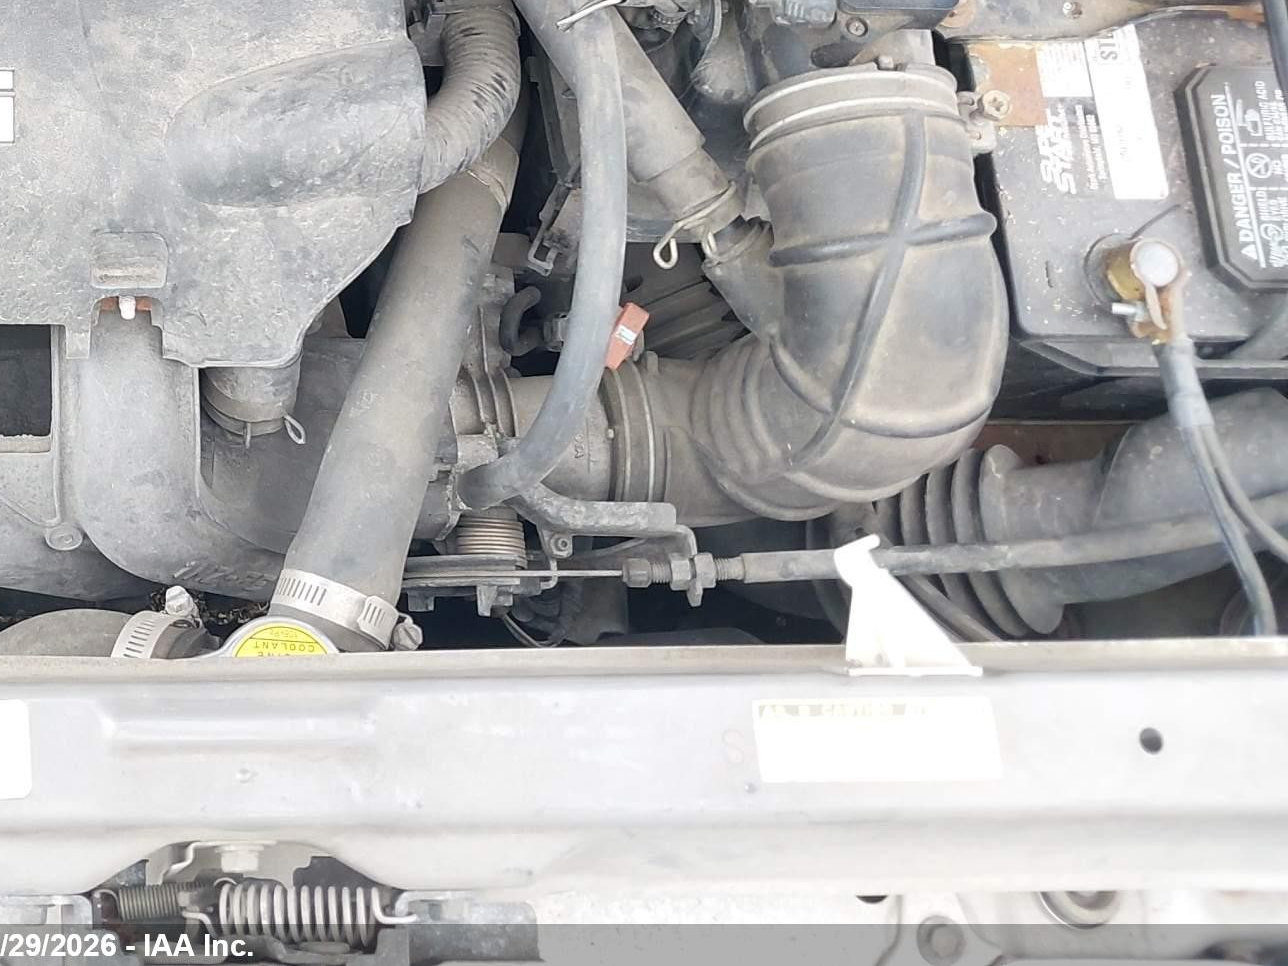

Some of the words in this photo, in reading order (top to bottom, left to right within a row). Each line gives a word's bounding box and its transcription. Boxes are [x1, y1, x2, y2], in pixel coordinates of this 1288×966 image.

[1254, 79, 1267, 100] ACID
[1046, 108, 1077, 194] START
[1211, 94, 1237, 155] POISON
[1227, 171, 1253, 242] DANGER
[254, 641, 315, 652] COOLANT
